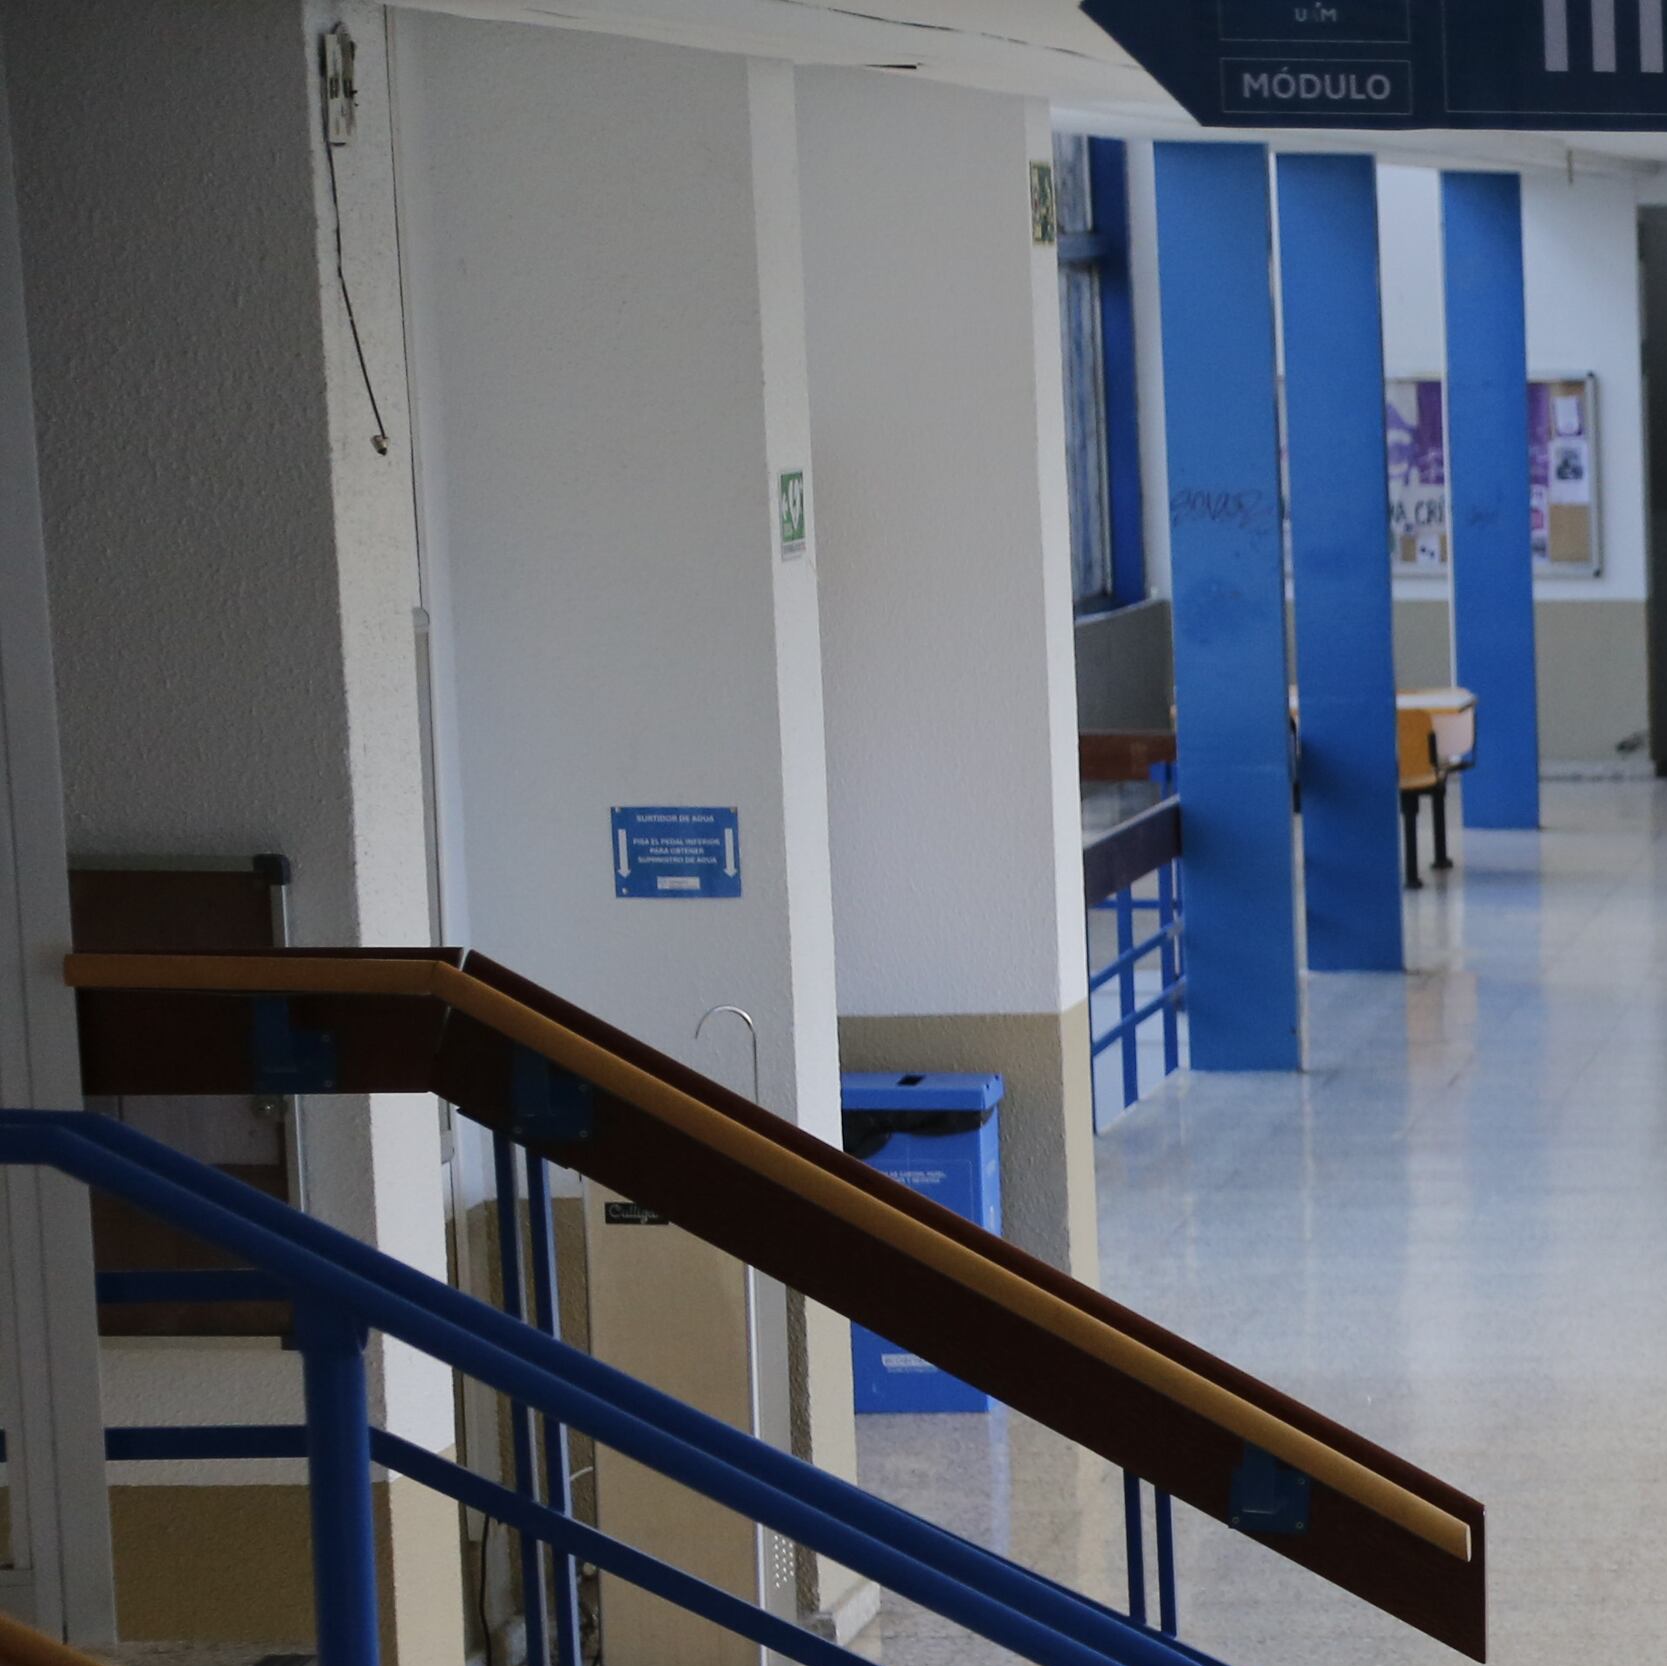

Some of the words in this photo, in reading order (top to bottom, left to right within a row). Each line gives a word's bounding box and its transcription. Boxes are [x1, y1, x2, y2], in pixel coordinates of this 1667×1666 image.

[1242, 66, 1391, 100] MÓDULO
[636, 814, 678, 822] SURTIDOR
[679, 814, 690, 822] DE
[692, 814, 715, 822] AGUA
